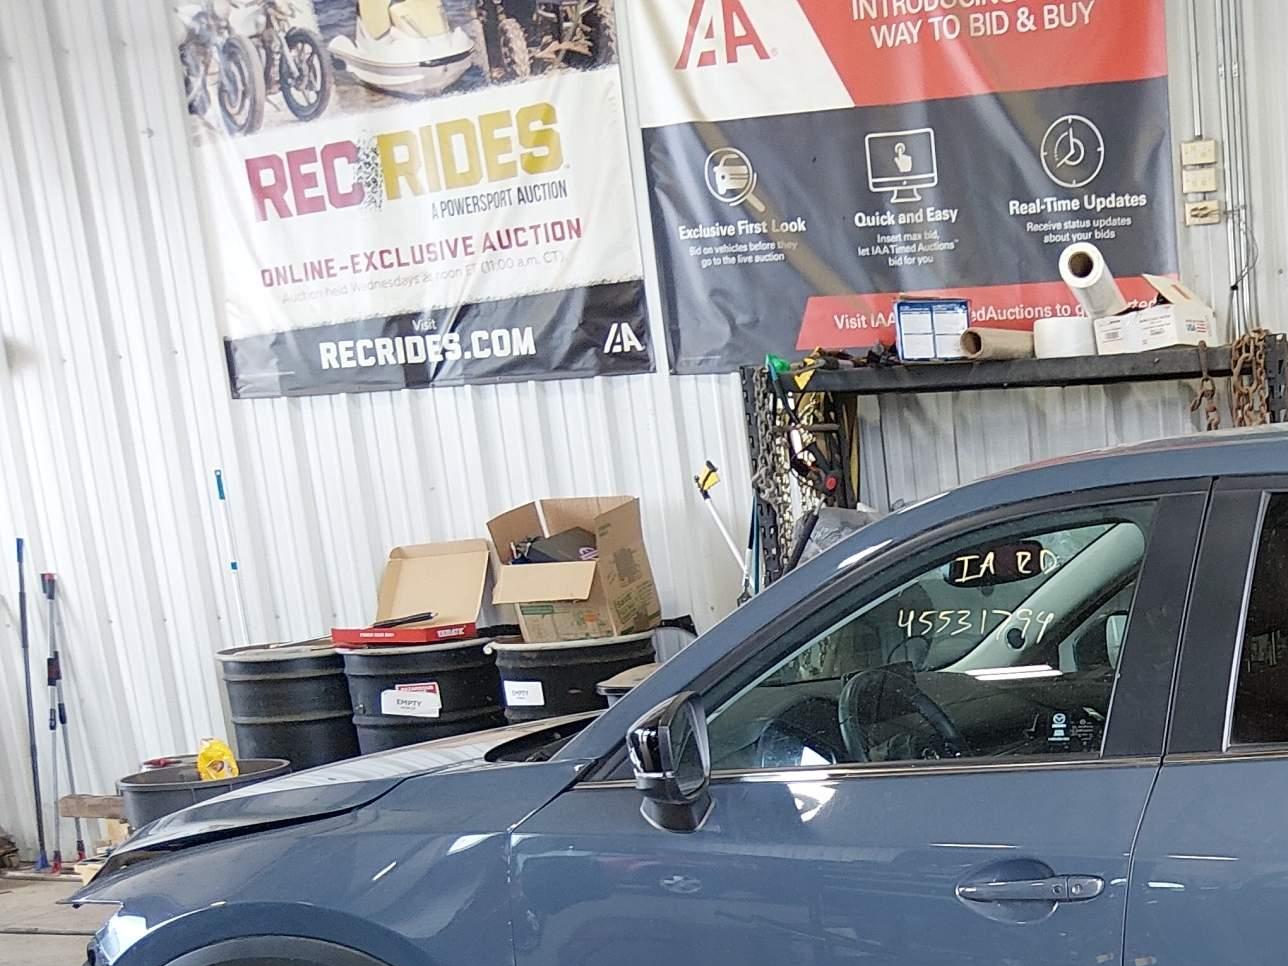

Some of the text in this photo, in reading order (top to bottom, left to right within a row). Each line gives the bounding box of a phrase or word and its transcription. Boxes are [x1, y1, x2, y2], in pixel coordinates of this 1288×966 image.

[870, 0, 1095, 48] WAY TO BID & BUY
[245, 102, 564, 222] REC RIDES
[432, 179, 569, 220] A POWERSPORT AUCTION
[1009, 192, 1148, 216] Real-Time Updates
[855, 206, 958, 228] Quick and Easy
[1026, 216, 1132, 232] Receive status updates
[678, 216, 807, 241] Exclusive First Look
[877, 230, 940, 244] Insert max bid,
[1043, 229, 1115, 243] about your bids
[260, 217, 584, 288] ONLINE-EXCLUSIVE AUCTION
[689, 240, 798, 256] Bid on vehicles before they
[858, 246, 870, 257] let
[872, 245, 890, 256] IAA
[890, 243, 917, 255] Timed
[701, 252, 785, 269] go to the live auction
[888, 255, 934, 267] bid for you
[353, 272, 419, 293] Wdnesdays
[412, 318, 437, 332] Visit
[834, 312, 867, 330] Visit
[1055, 303, 1071, 317] to
[319, 327, 537, 370] RECRIDES.COM
[898, 608, 1054, 644] 45531794
